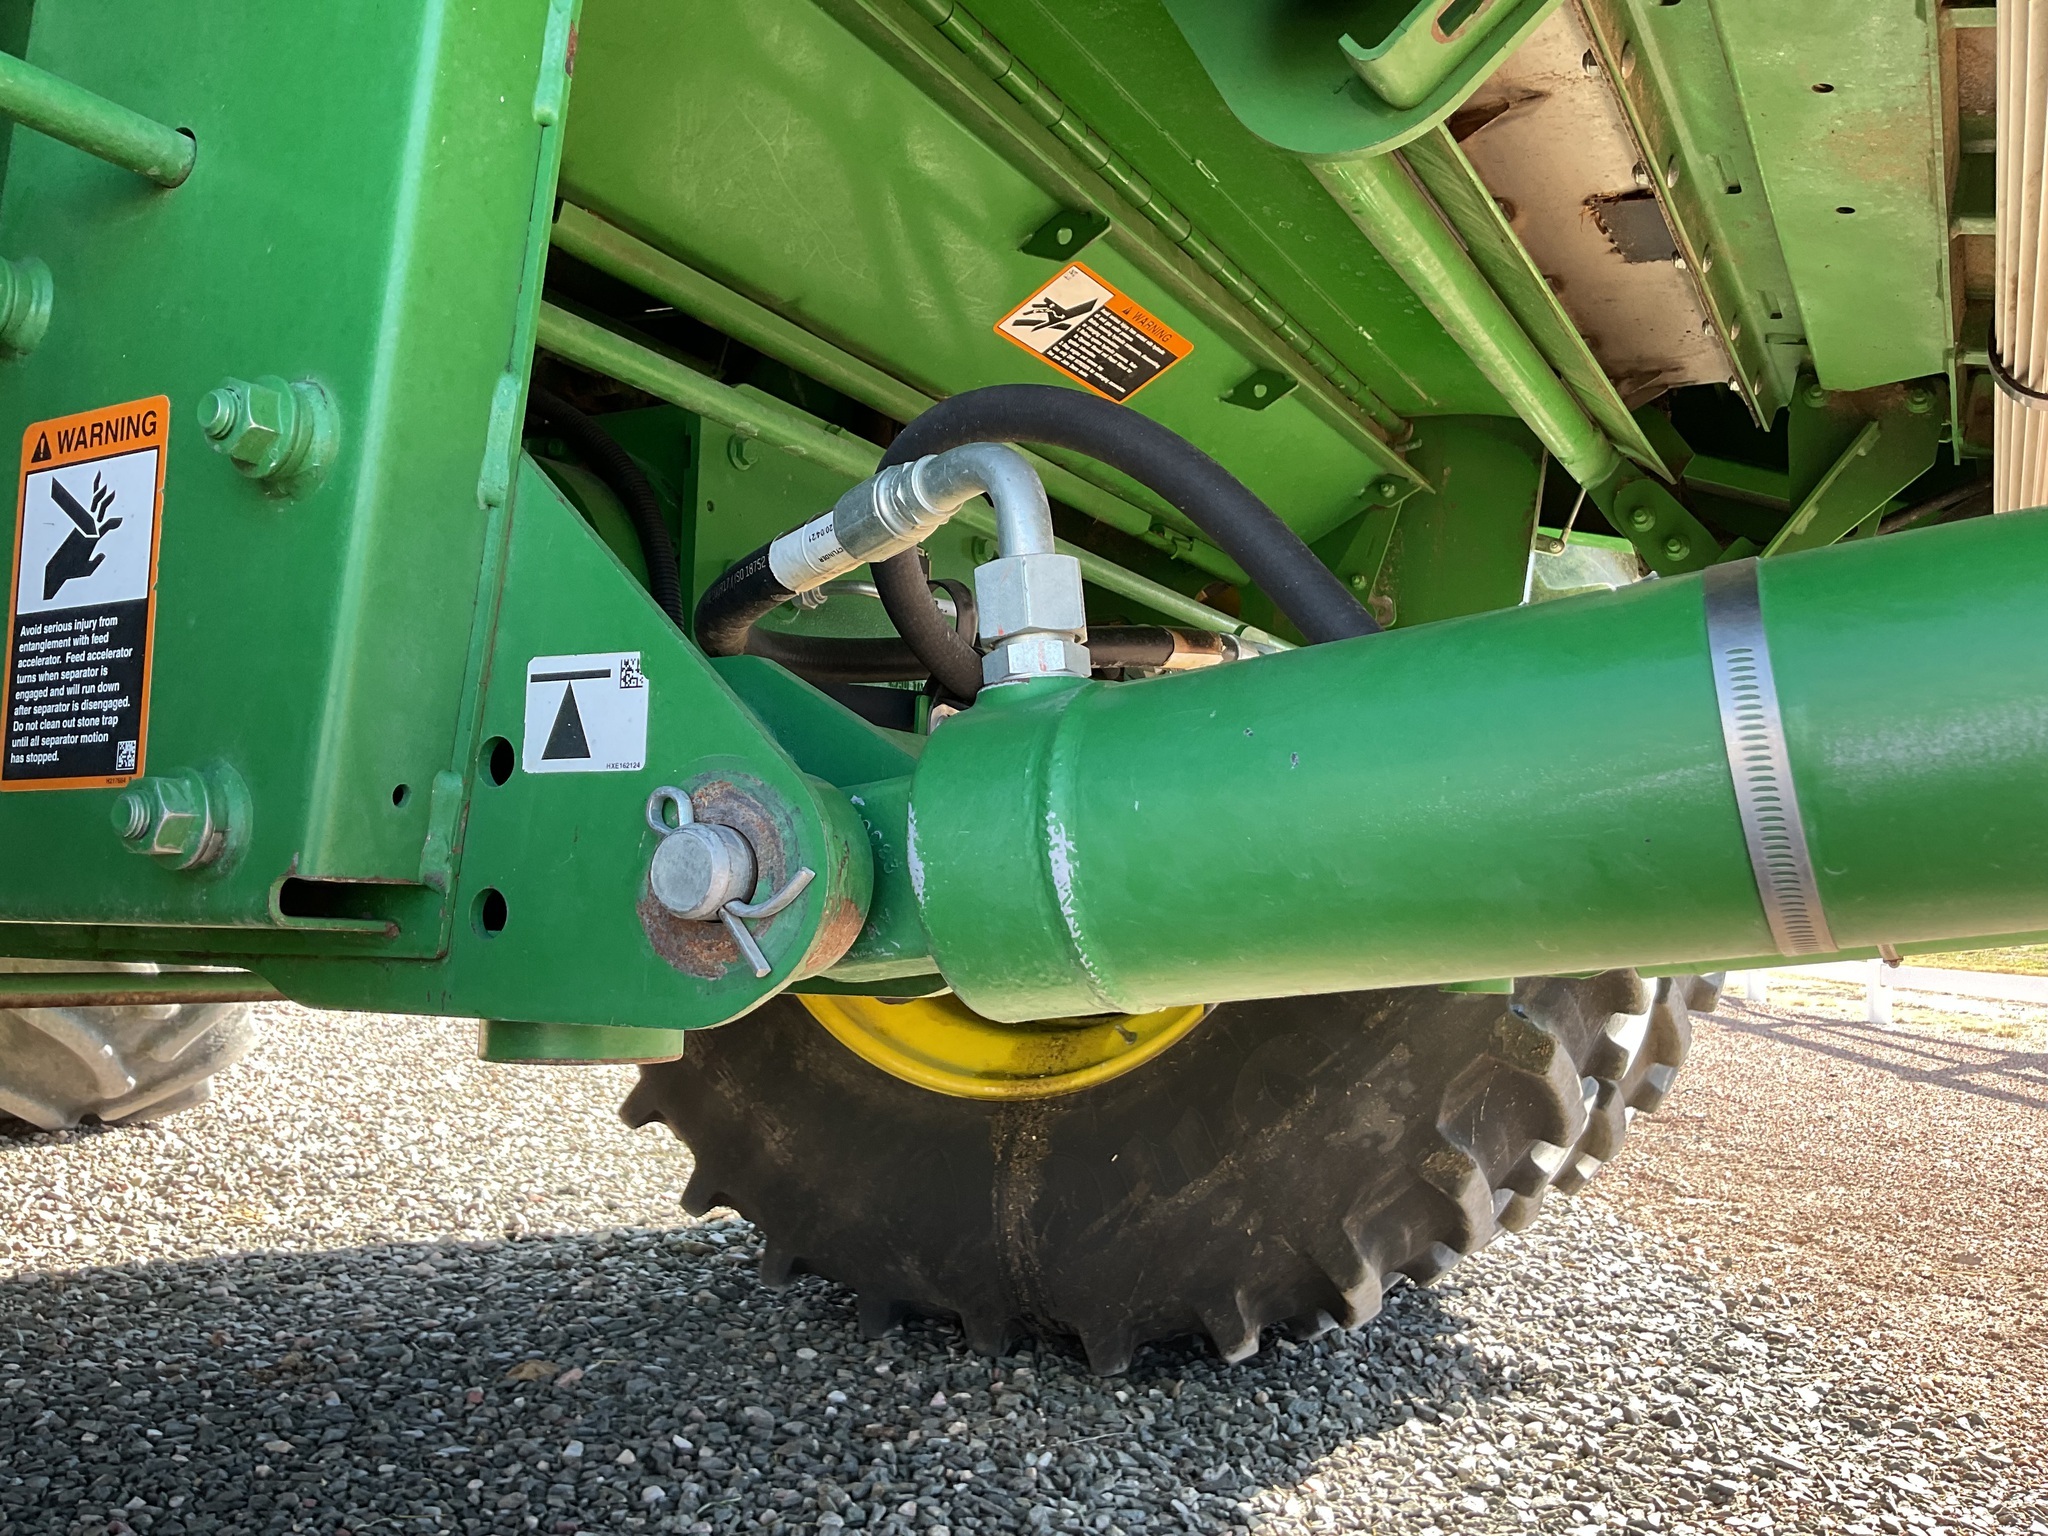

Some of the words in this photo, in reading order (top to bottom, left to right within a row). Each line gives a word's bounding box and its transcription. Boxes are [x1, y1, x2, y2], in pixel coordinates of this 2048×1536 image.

[1132, 310, 1173, 343] WARNING
[58, 410, 157, 454] WARNING
[818, 547, 844, 563] CYLINDER
[21, 623, 42, 637] Avoid
[43, 623, 72, 634] serious
[74, 619, 96, 631] injury
[99, 615, 118, 627] from
[19, 638, 71, 653] entanglement
[73, 634, 89, 646] with
[92, 632, 109, 644] feed
[18, 655, 61, 668] accelerator.
[66, 651, 85, 663] Feed
[87, 647, 133, 660] accelerator
[17, 673, 36, 684] turns
[38, 670, 58, 681] when
[61, 666, 98, 681] separator
[101, 666, 108, 676] is
[15, 688, 48, 702] engaged
[50, 685, 64, 696] and
[67, 684, 80, 695] will
[82, 685, 95, 694] run
[98, 681, 119, 692] down
[14, 703, 31, 716] after
[33, 701, 70, 716] separator
[72, 700, 79, 711] is
[81, 696, 130, 710] disengaged.
[13, 721, 23, 731] Do
[25, 720, 38, 731] not
[40, 718, 60, 729] clean
[62, 717, 75, 727] out
[77, 716, 100, 726] stone
[102, 715, 118, 727] trap
[12, 736, 28, 747] until
[30, 735, 39, 747] all
[41, 734, 79, 748] separator
[80, 732, 108, 743] motion
[10, 752, 24, 763] has
[26, 751, 59, 765] stopped.
